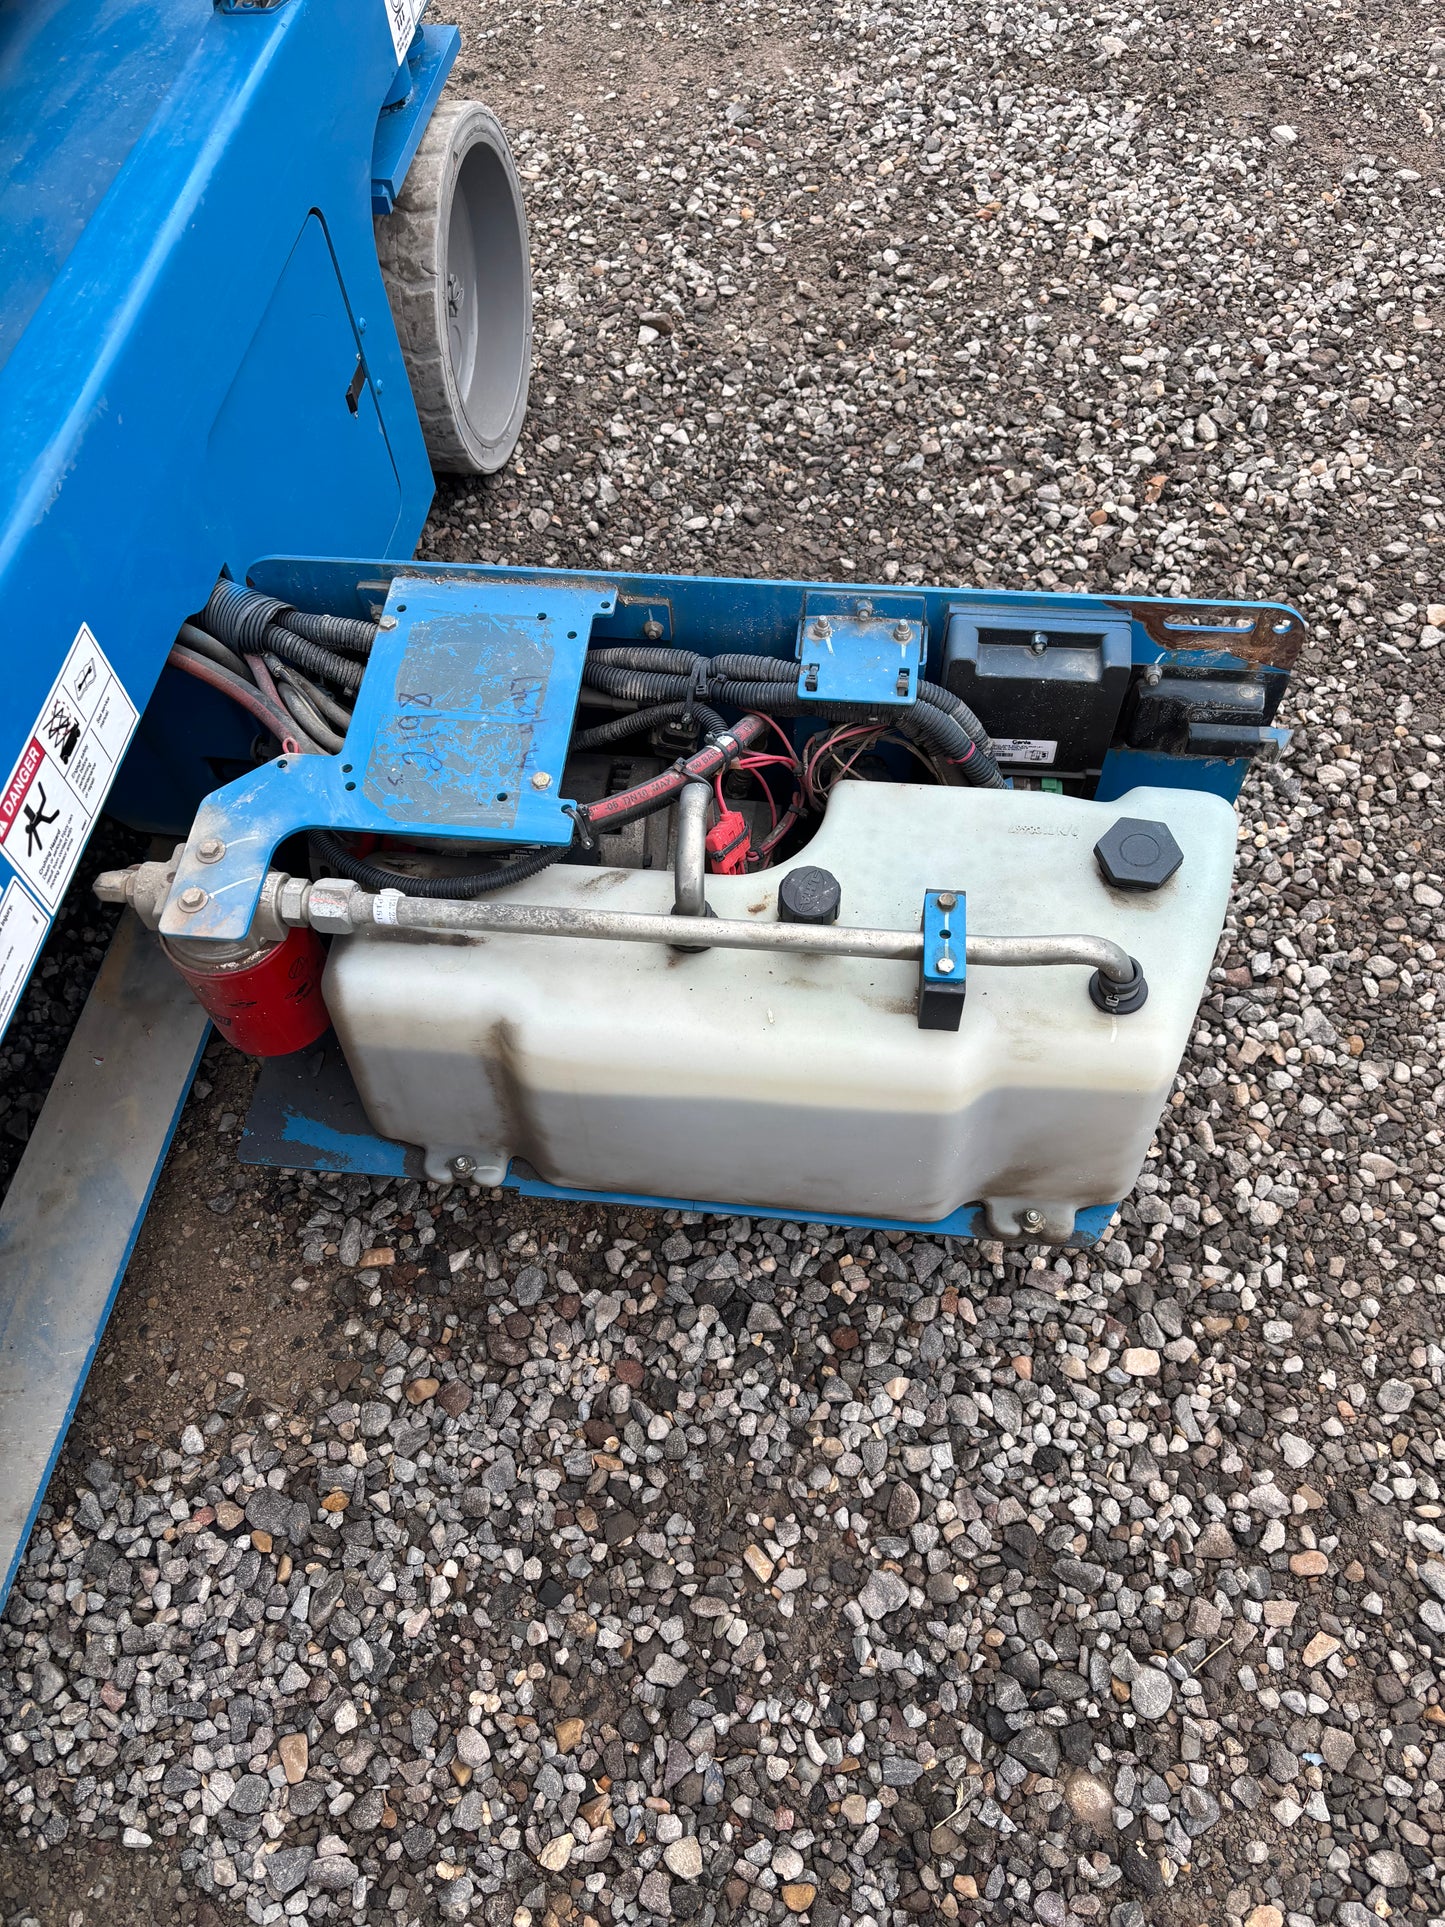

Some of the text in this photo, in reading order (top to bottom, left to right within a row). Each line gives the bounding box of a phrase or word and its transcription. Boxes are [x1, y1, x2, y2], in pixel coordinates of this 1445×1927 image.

[702, 750, 719, 764] BAR
[3, 746, 41, 817] DANGER
[622, 789, 648, 806] DN10
[39, 828, 61, 875] Crushing Hazard
